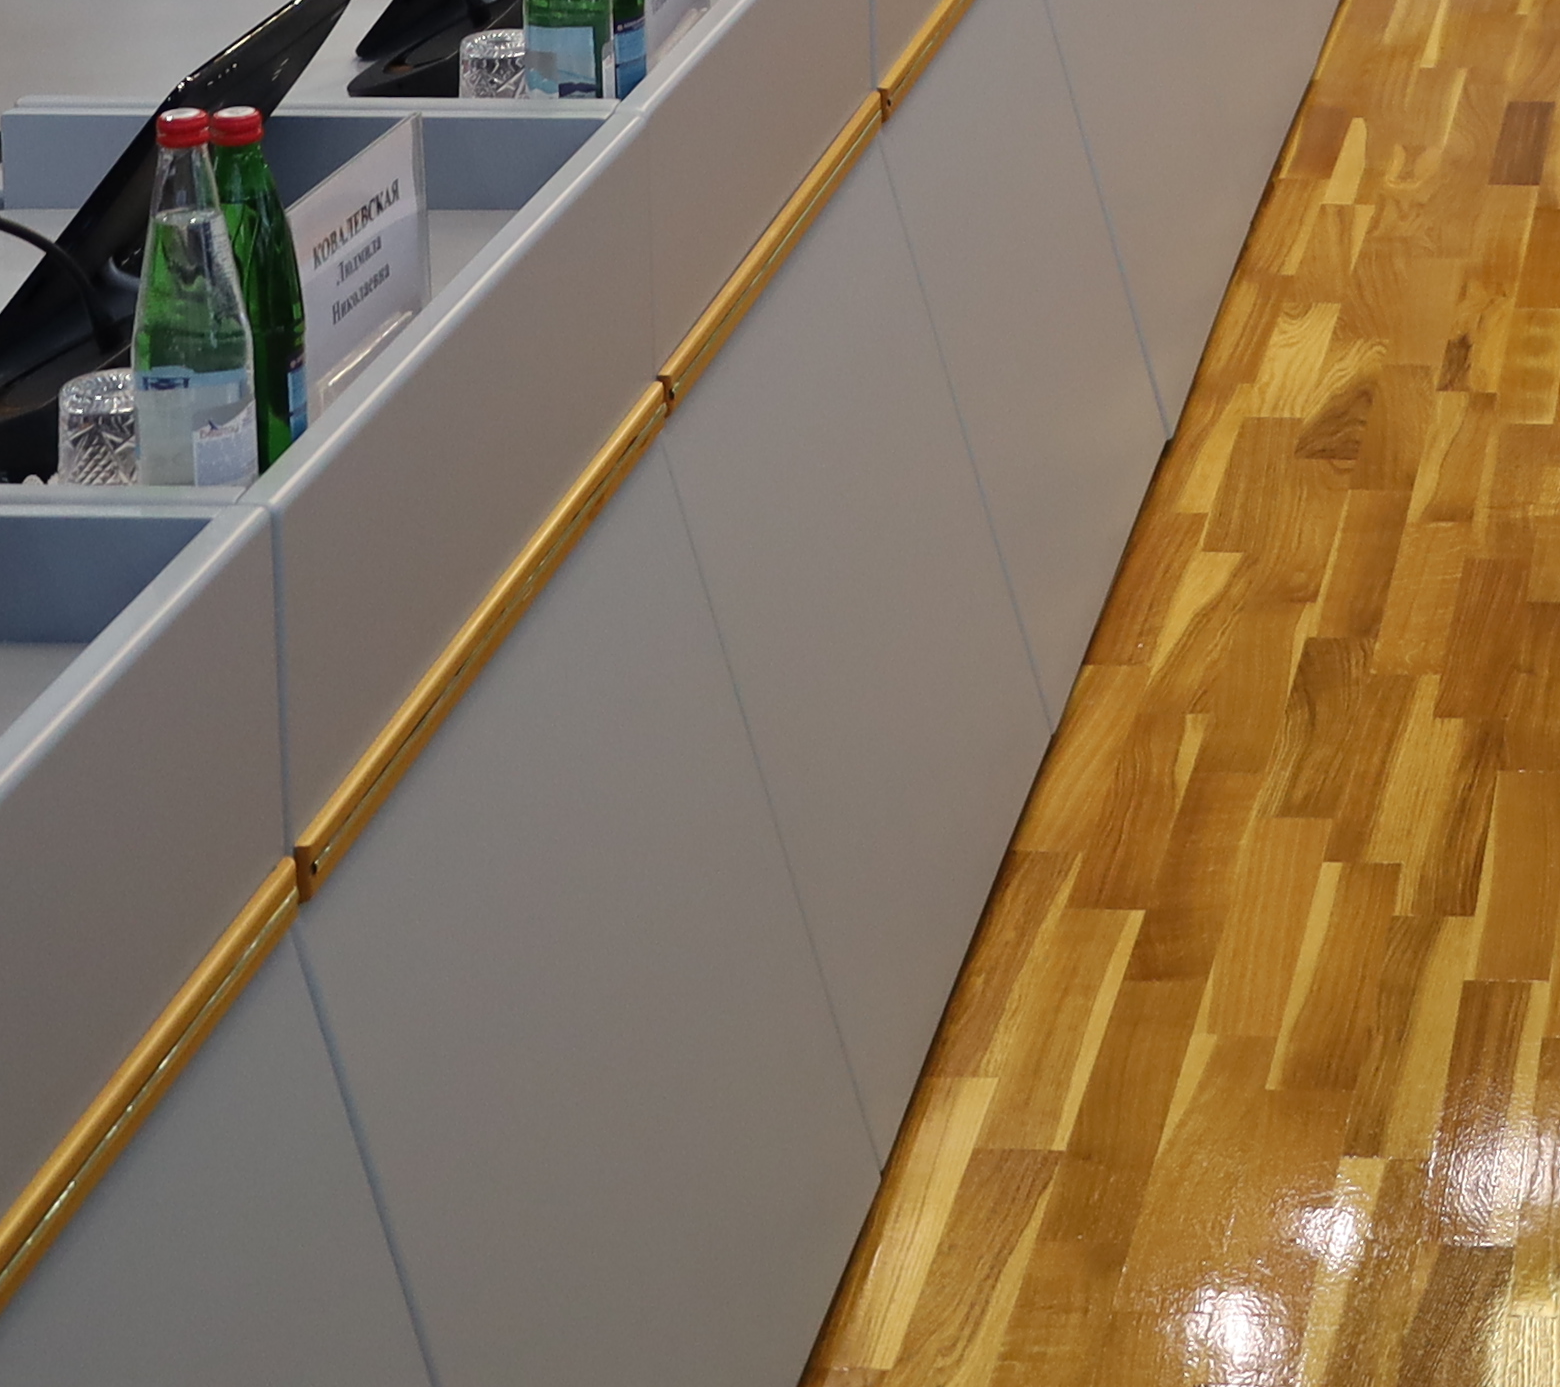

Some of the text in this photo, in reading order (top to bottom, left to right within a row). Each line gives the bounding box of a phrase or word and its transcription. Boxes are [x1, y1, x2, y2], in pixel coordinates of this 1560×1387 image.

[312, 178, 401, 271] КОВАЛЕВСКАЯ
[336, 235, 383, 287] Людмила
[331, 262, 391, 326] Николаевна
